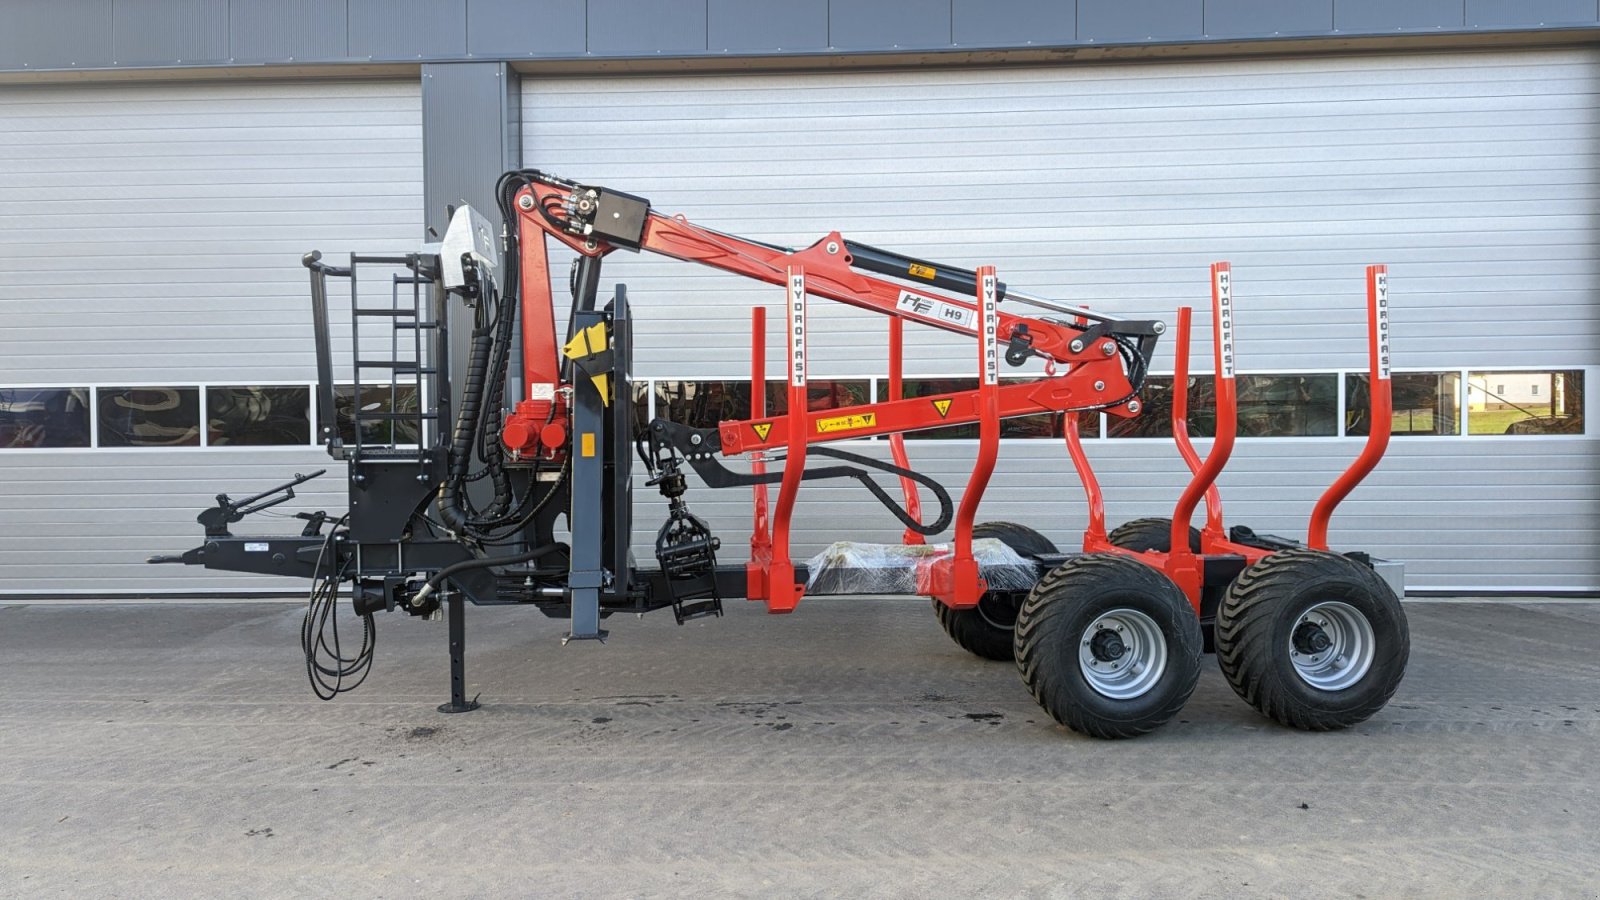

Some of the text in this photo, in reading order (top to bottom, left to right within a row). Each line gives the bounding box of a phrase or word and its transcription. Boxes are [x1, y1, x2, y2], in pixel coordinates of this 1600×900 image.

[794, 278, 803, 383] HYDROFAST
[944, 308, 962, 321] H9
[985, 278, 996, 382] HYDROFAST
[1220, 274, 1233, 375] HYDROFAST
[1379, 276, 1389, 376] HYDROFAST
